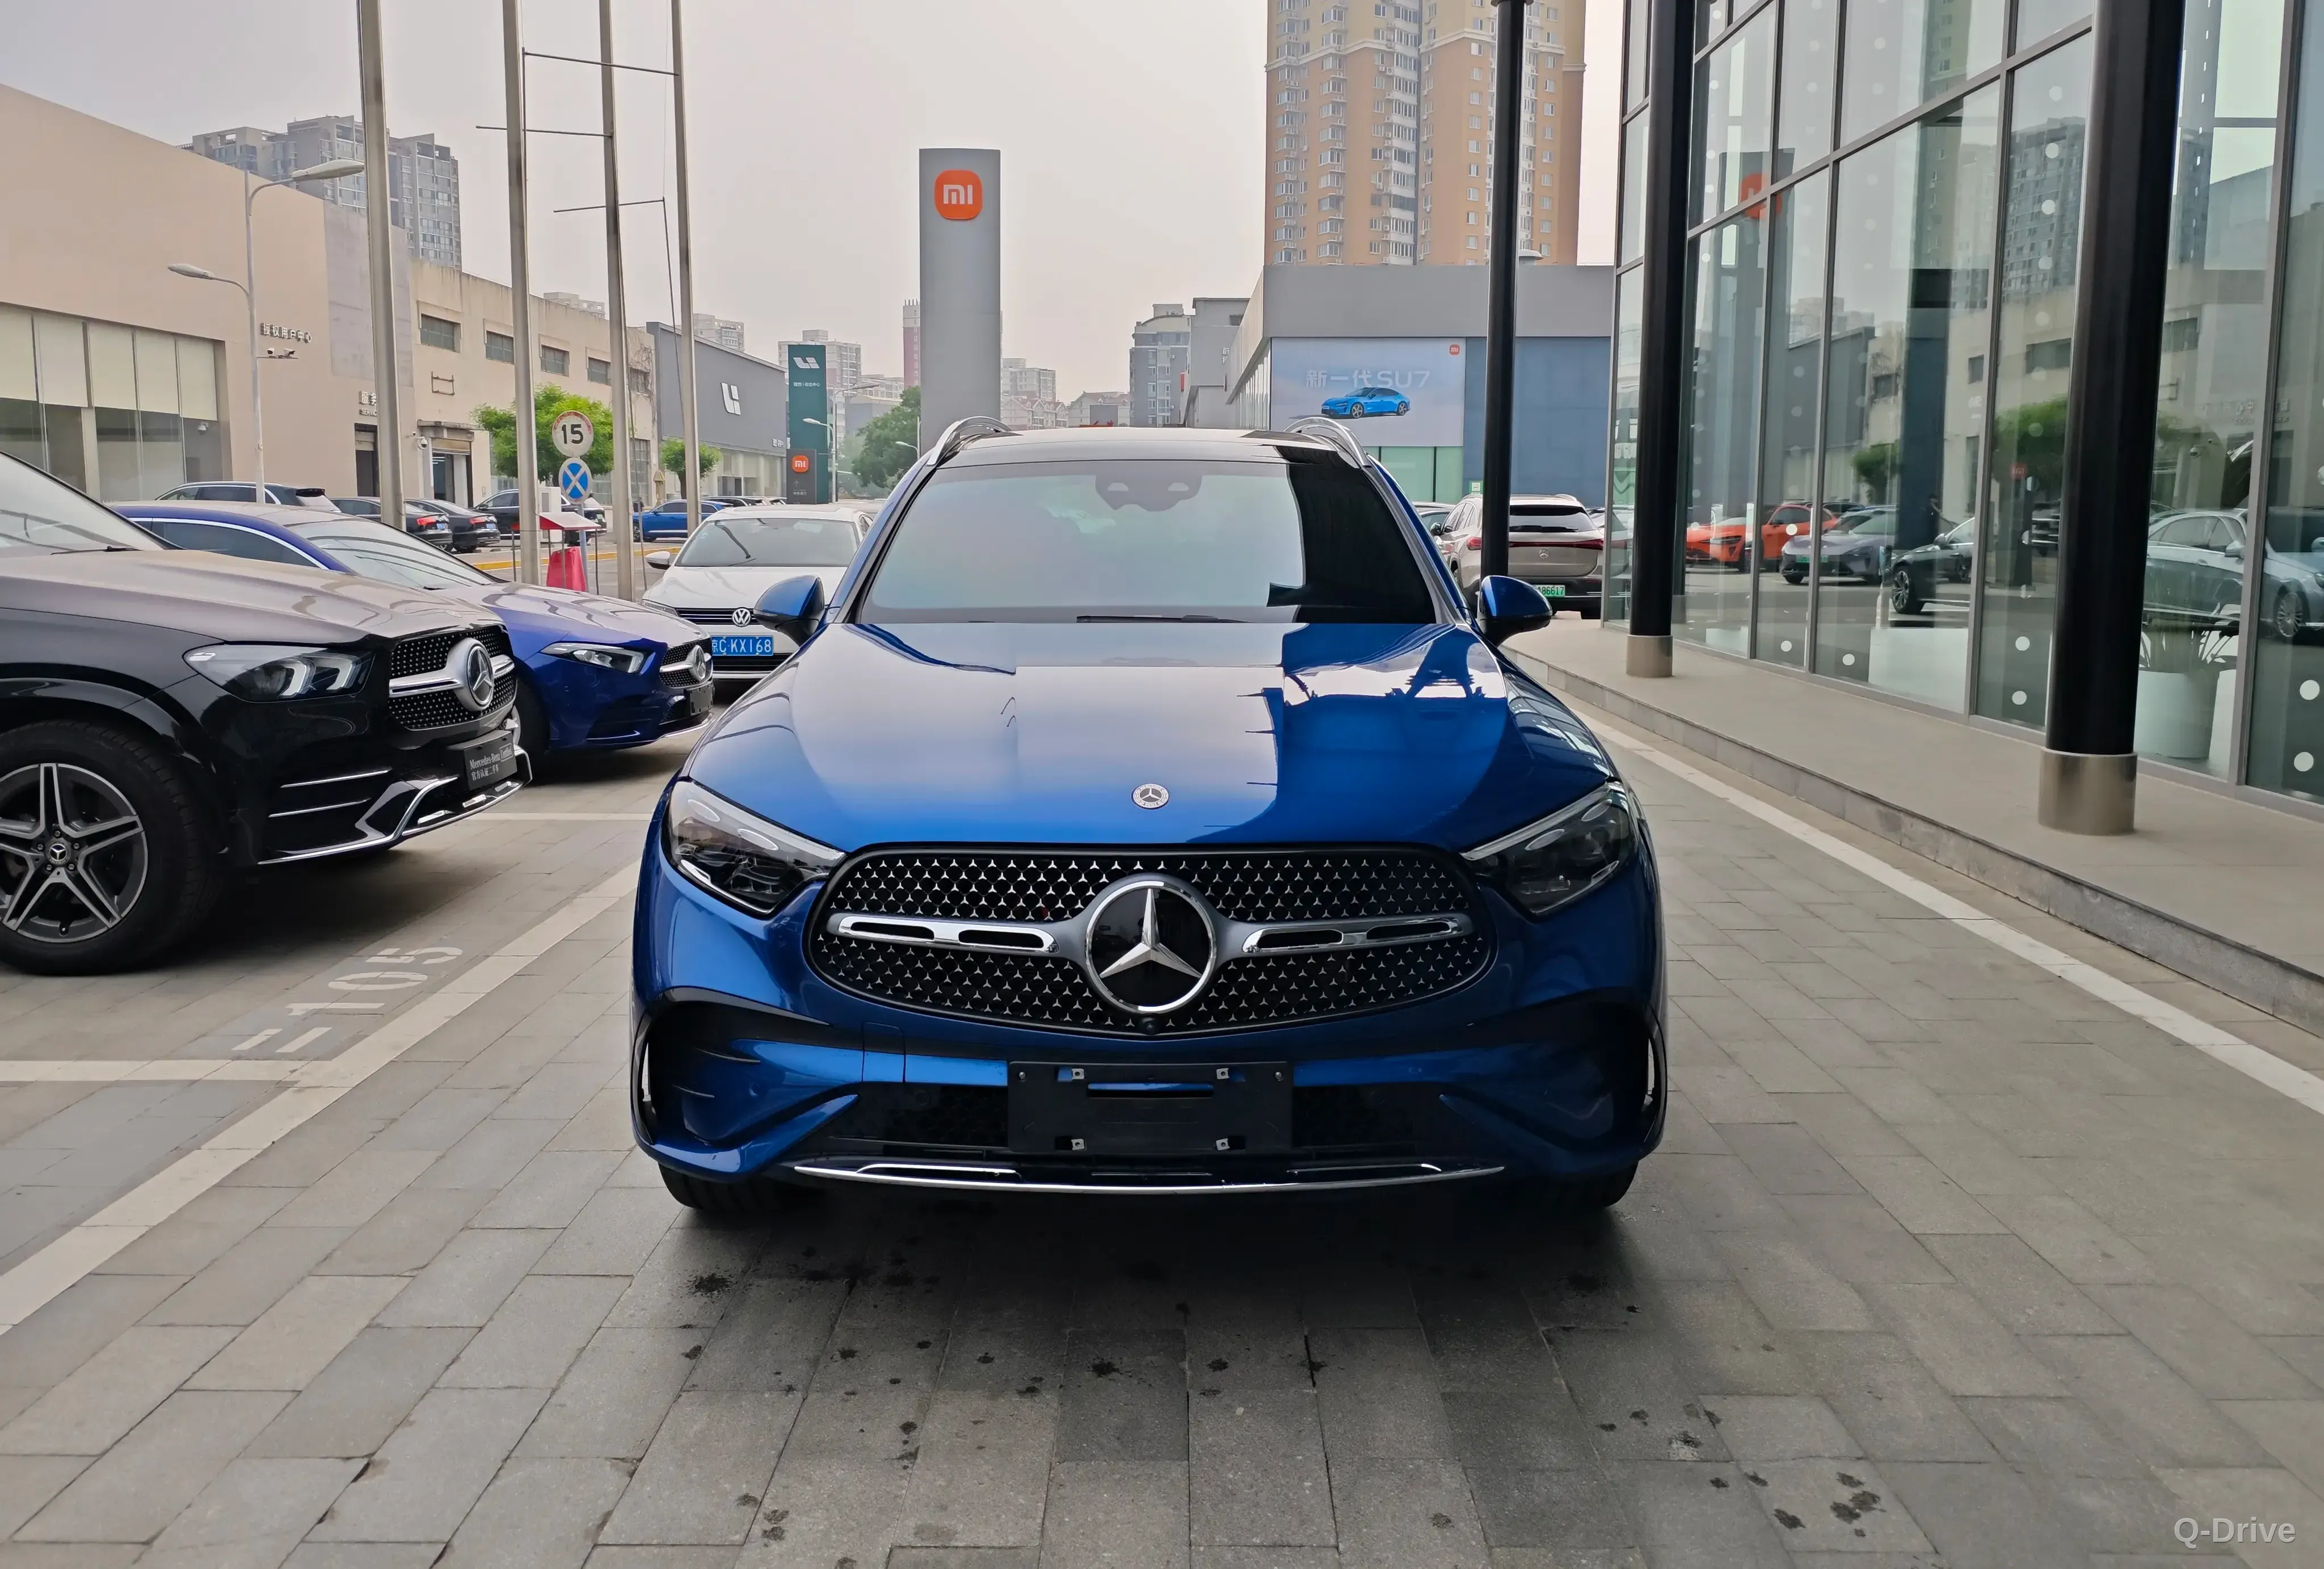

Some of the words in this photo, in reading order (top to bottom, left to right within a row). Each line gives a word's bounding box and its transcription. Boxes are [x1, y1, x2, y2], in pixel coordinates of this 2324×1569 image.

[261, 323, 312, 343] 授权用户中心
[360, 408, 377, 417] SERVIC
[562, 424, 584, 444] 15
[470, 753, 500, 769] Mercedes-Benz
[471, 764, 499, 781] 官方认证二手车
